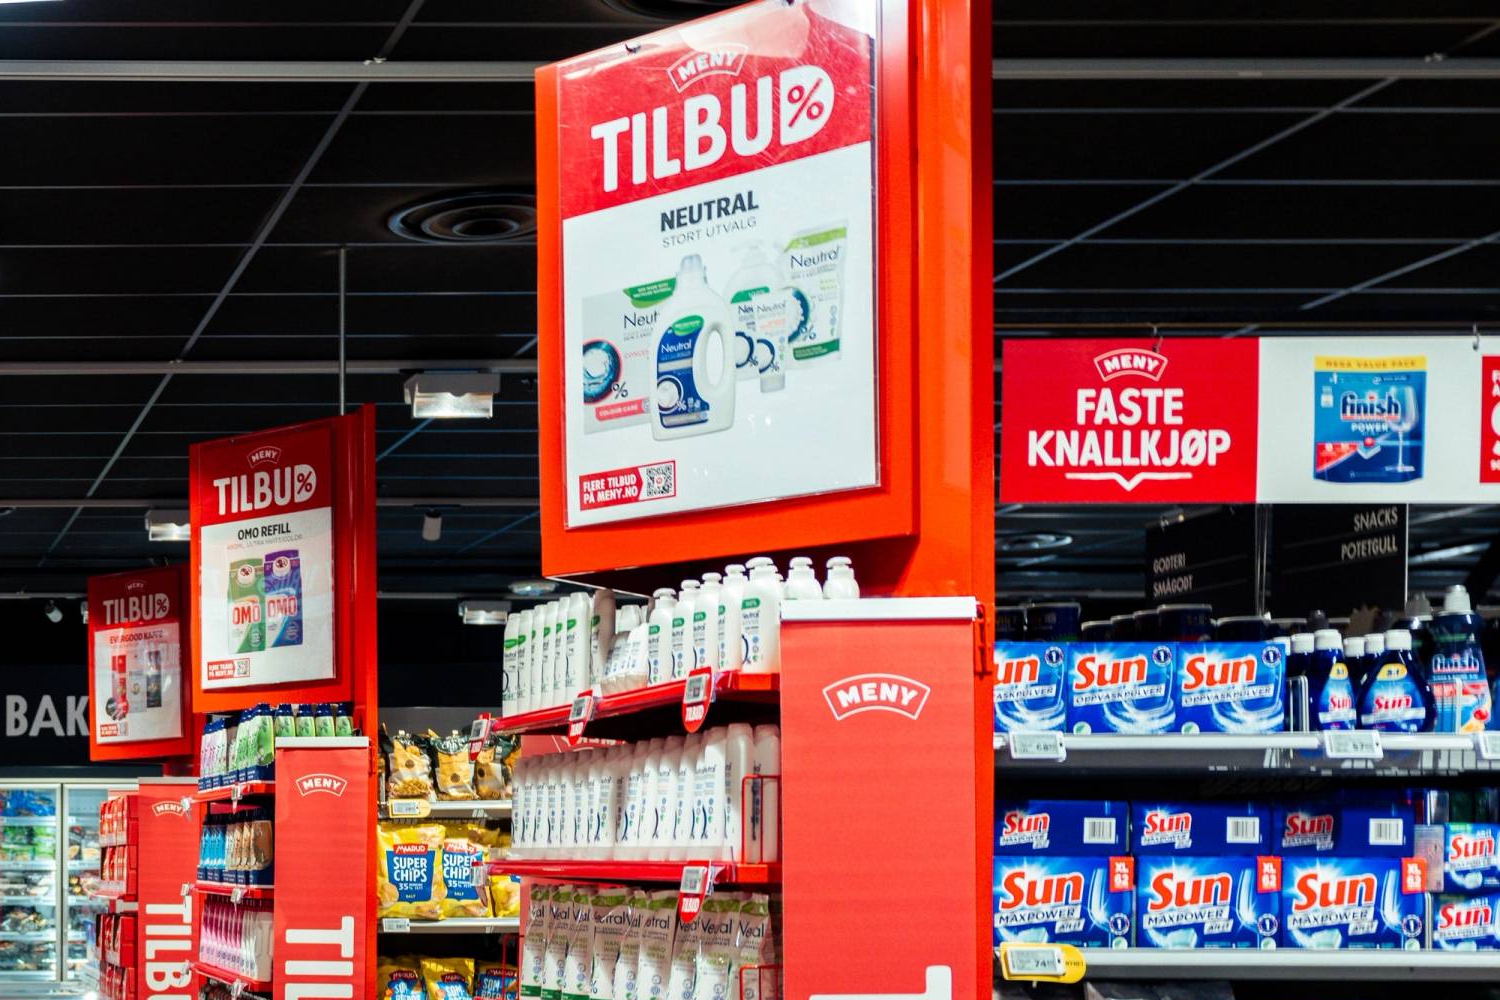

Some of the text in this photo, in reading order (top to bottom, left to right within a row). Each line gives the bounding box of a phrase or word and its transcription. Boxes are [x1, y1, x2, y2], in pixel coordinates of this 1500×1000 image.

[678, 52, 739, 81] MENY
[590, 64, 835, 193] TILBUD
[660, 190, 759, 232] NEUTRAL
[662, 216, 757, 248] STORT UTVALG
[789, 245, 841, 269] Neutral
[660, 339, 692, 353] Neutral
[1104, 354, 1160, 373] MENY
[1076, 388, 1184, 425] FASTE
[1341, 391, 1401, 418] finish
[1350, 422, 1390, 433] POWER
[251, 450, 277, 463] MENY
[1027, 429, 1232, 467] KNALLKJØP
[212, 463, 317, 516] TILBUD
[583, 473, 637, 492] FLERE TILBUD
[583, 486, 639, 505] PÅ MENY.NO
[1353, 506, 1399, 532] SNACKS
[237, 522, 291, 541] OMO REFILL
[1341, 534, 1398, 561] POTETGULL
[1153, 553, 1186, 575] GODTERI
[1153, 574, 1194, 598] SMÅGODT
[102, 592, 170, 625] TILBUD
[233, 604, 261, 625] OMO
[267, 595, 297, 617] OMO
[995, 657, 1040, 686] un
[1073, 656, 1148, 691] Sun
[1183, 656, 1257, 691] Sun
[836, 682, 919, 709] MENY
[1074, 685, 1166, 706] OPPVASKPULVER
[1182, 685, 1274, 706] OPPVASKPULVER
[1329, 694, 1352, 710] Sun
[1373, 695, 1413, 711] Sun
[5, 694, 90, 737] BAK
[302, 779, 341, 792] MENY
[155, 803, 184, 813] MENY
[1002, 812, 1050, 836] Sun
[1145, 812, 1192, 836] Sun
[1286, 814, 1333, 838] Sun
[395, 845, 426, 854] MAARUD
[1449, 834, 1495, 860] Sun
[393, 856, 428, 870] SUPER
[443, 866, 470, 880] CHIP
[1114, 861, 1130, 874] XL
[1262, 862, 1277, 875] XL
[1407, 863, 1421, 875] XL
[393, 868, 428, 883] CHIPS
[398, 883, 409, 891] 35
[1000, 870, 1084, 911] Sun
[1148, 870, 1234, 912] Sun
[1293, 872, 1377, 912] Sun
[998, 907, 1076, 925] MAXPOWER
[1147, 908, 1224, 926] MAXPOWER
[1291, 910, 1369, 927] MAXPOWER
[1439, 904, 1493, 929] Sun
